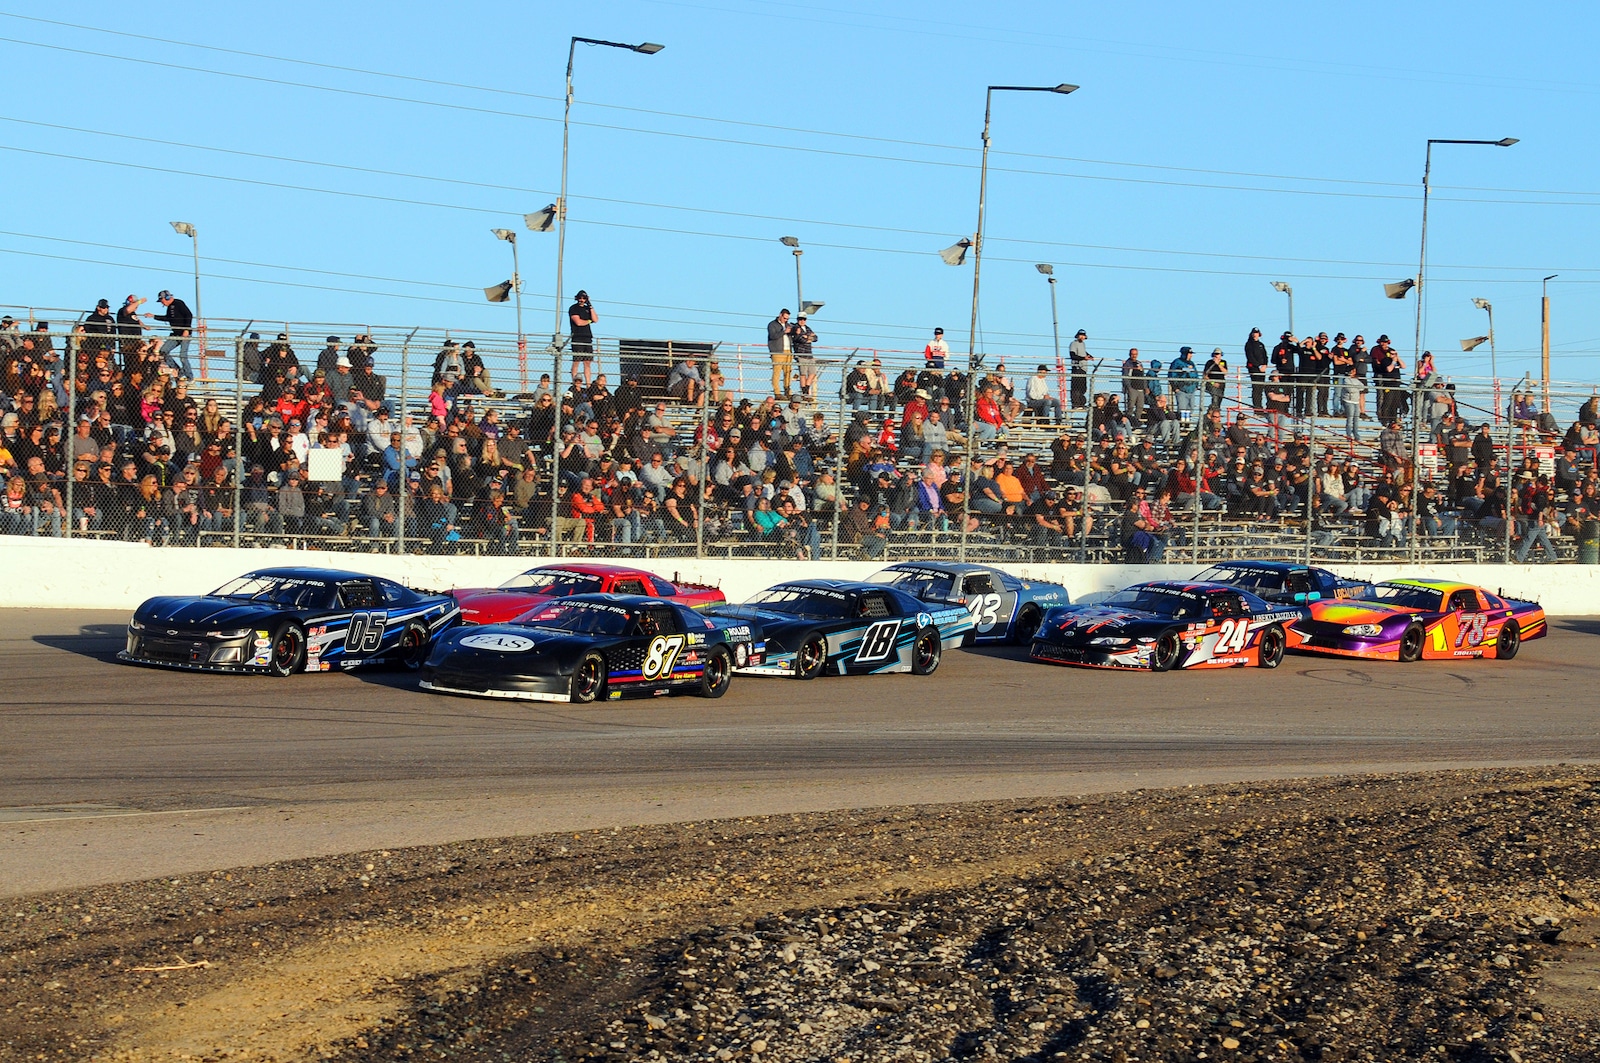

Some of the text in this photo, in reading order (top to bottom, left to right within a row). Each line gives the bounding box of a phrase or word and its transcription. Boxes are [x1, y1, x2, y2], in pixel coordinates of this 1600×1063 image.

[727, 626, 751, 635] ROLLER
[1252, 613, 1274, 622] LIBERTY
[1454, 612, 1487, 648] 78
[344, 611, 387, 653] 05
[468, 634, 528, 650] FAS
[855, 620, 902, 662] 18
[1213, 618, 1251, 656] 24
[340, 658, 385, 667] COOPER
[642, 633, 686, 681] 87
[1207, 657, 1249, 665] DEMPSTER
